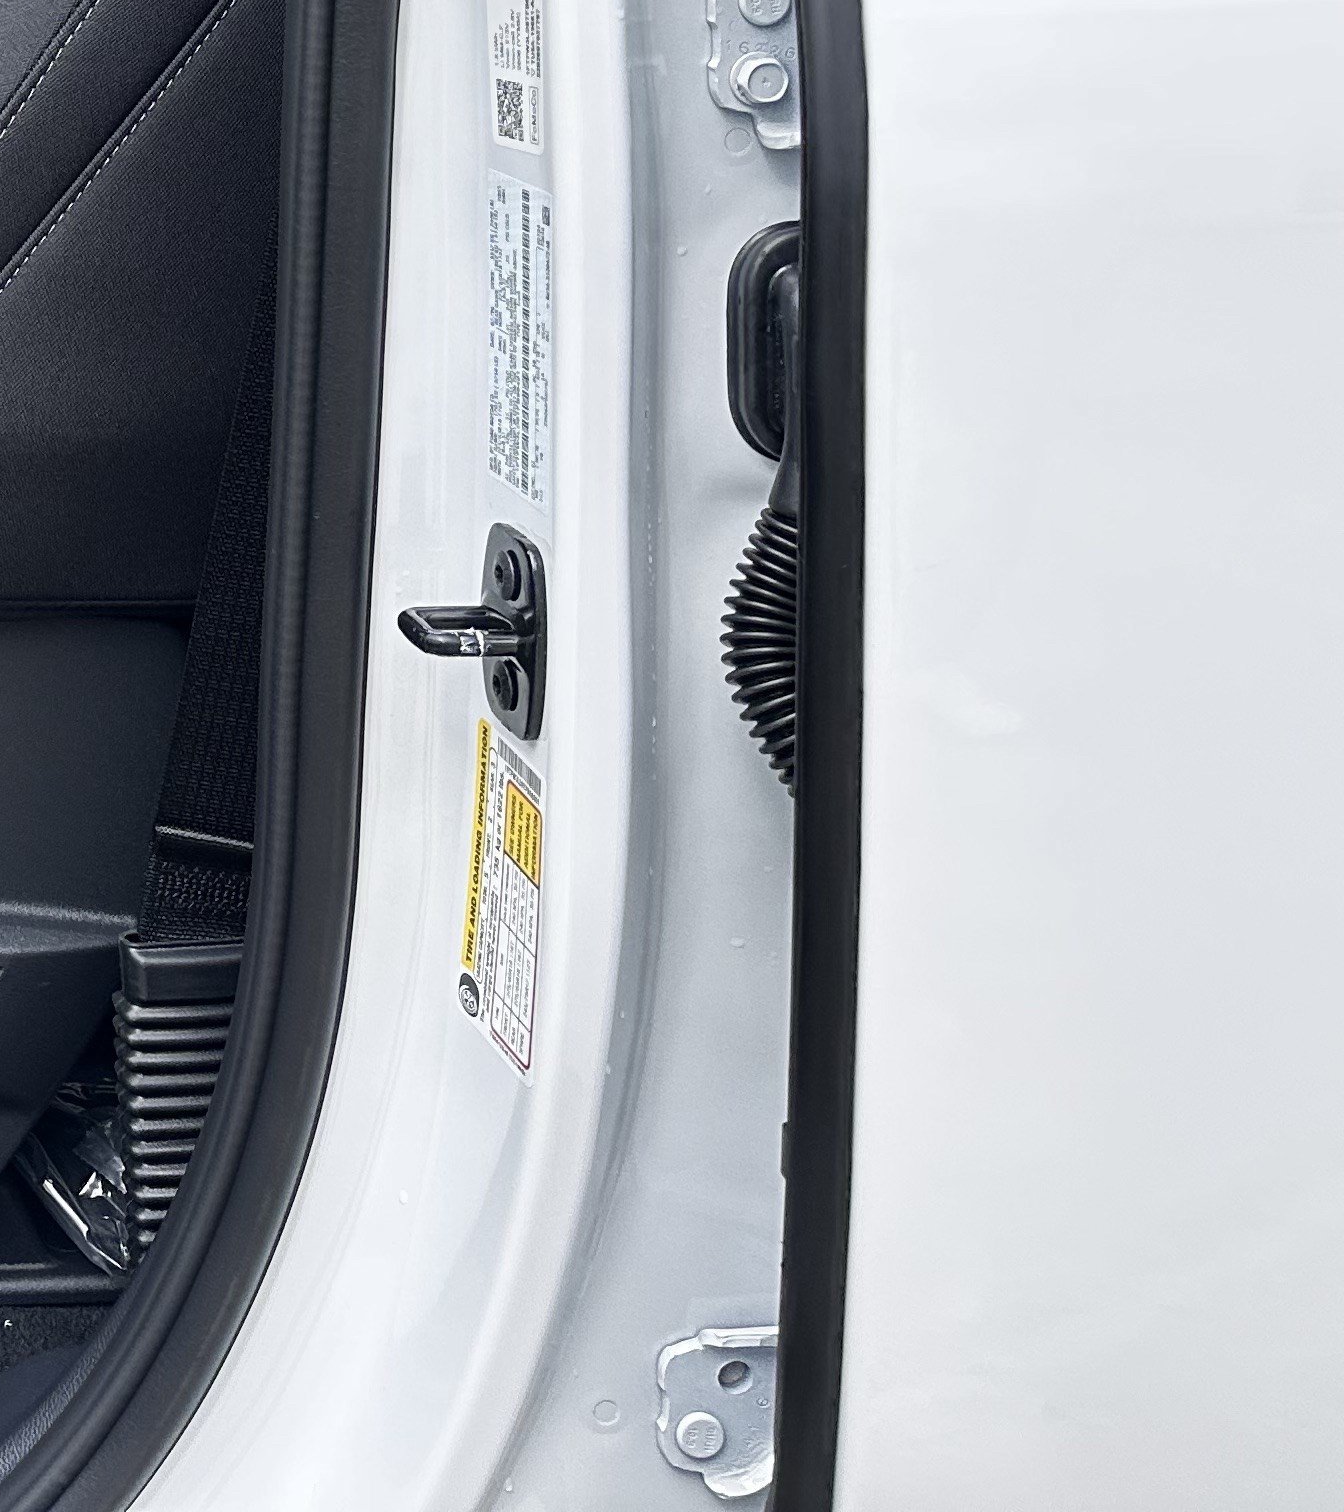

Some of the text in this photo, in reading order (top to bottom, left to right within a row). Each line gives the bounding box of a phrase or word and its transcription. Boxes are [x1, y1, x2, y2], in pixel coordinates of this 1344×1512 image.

[465, 724, 490, 963] TIRE AND LOADING INFORMATION
